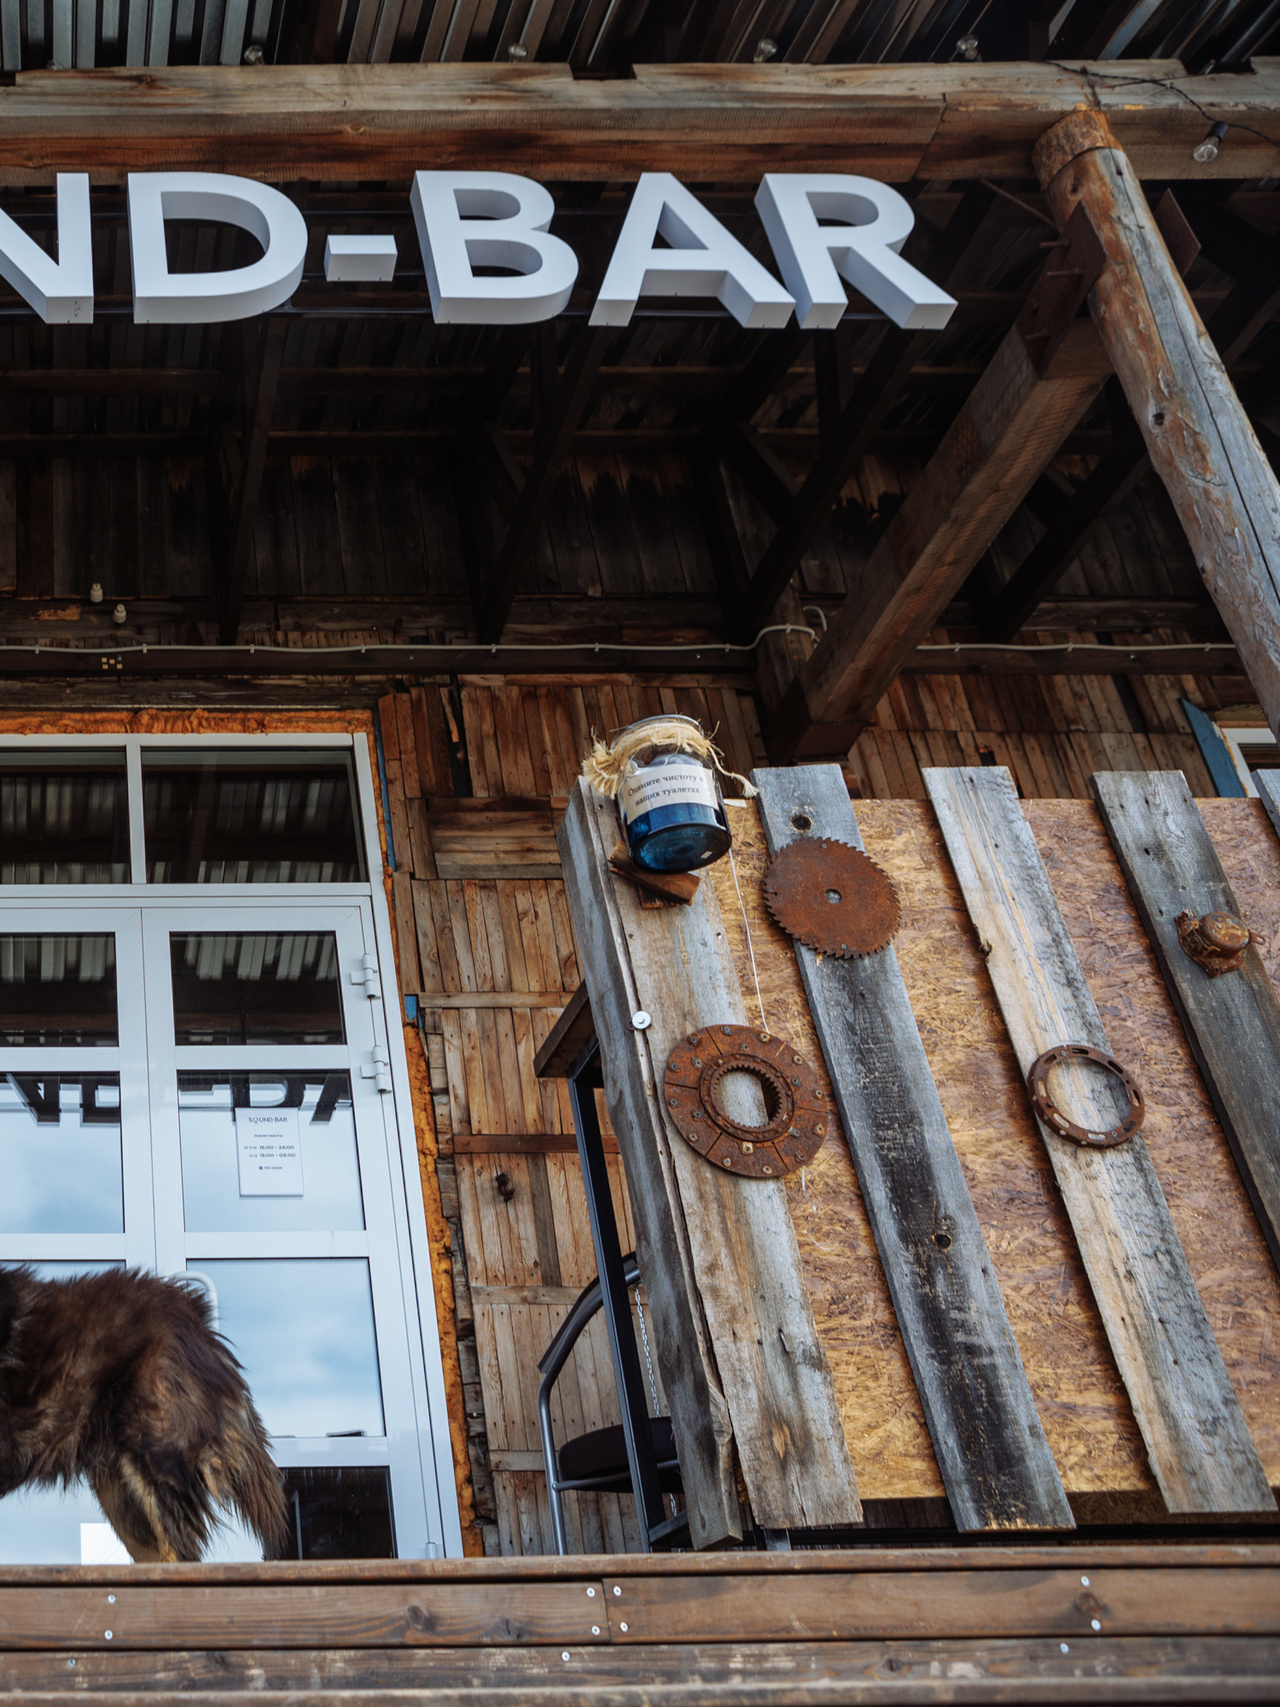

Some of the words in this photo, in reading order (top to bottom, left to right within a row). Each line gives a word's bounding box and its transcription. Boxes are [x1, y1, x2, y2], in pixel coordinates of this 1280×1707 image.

[628, 778, 660, 796] Оцените
[635, 791, 660, 806] наших
[662, 787, 700, 797] туалетах
